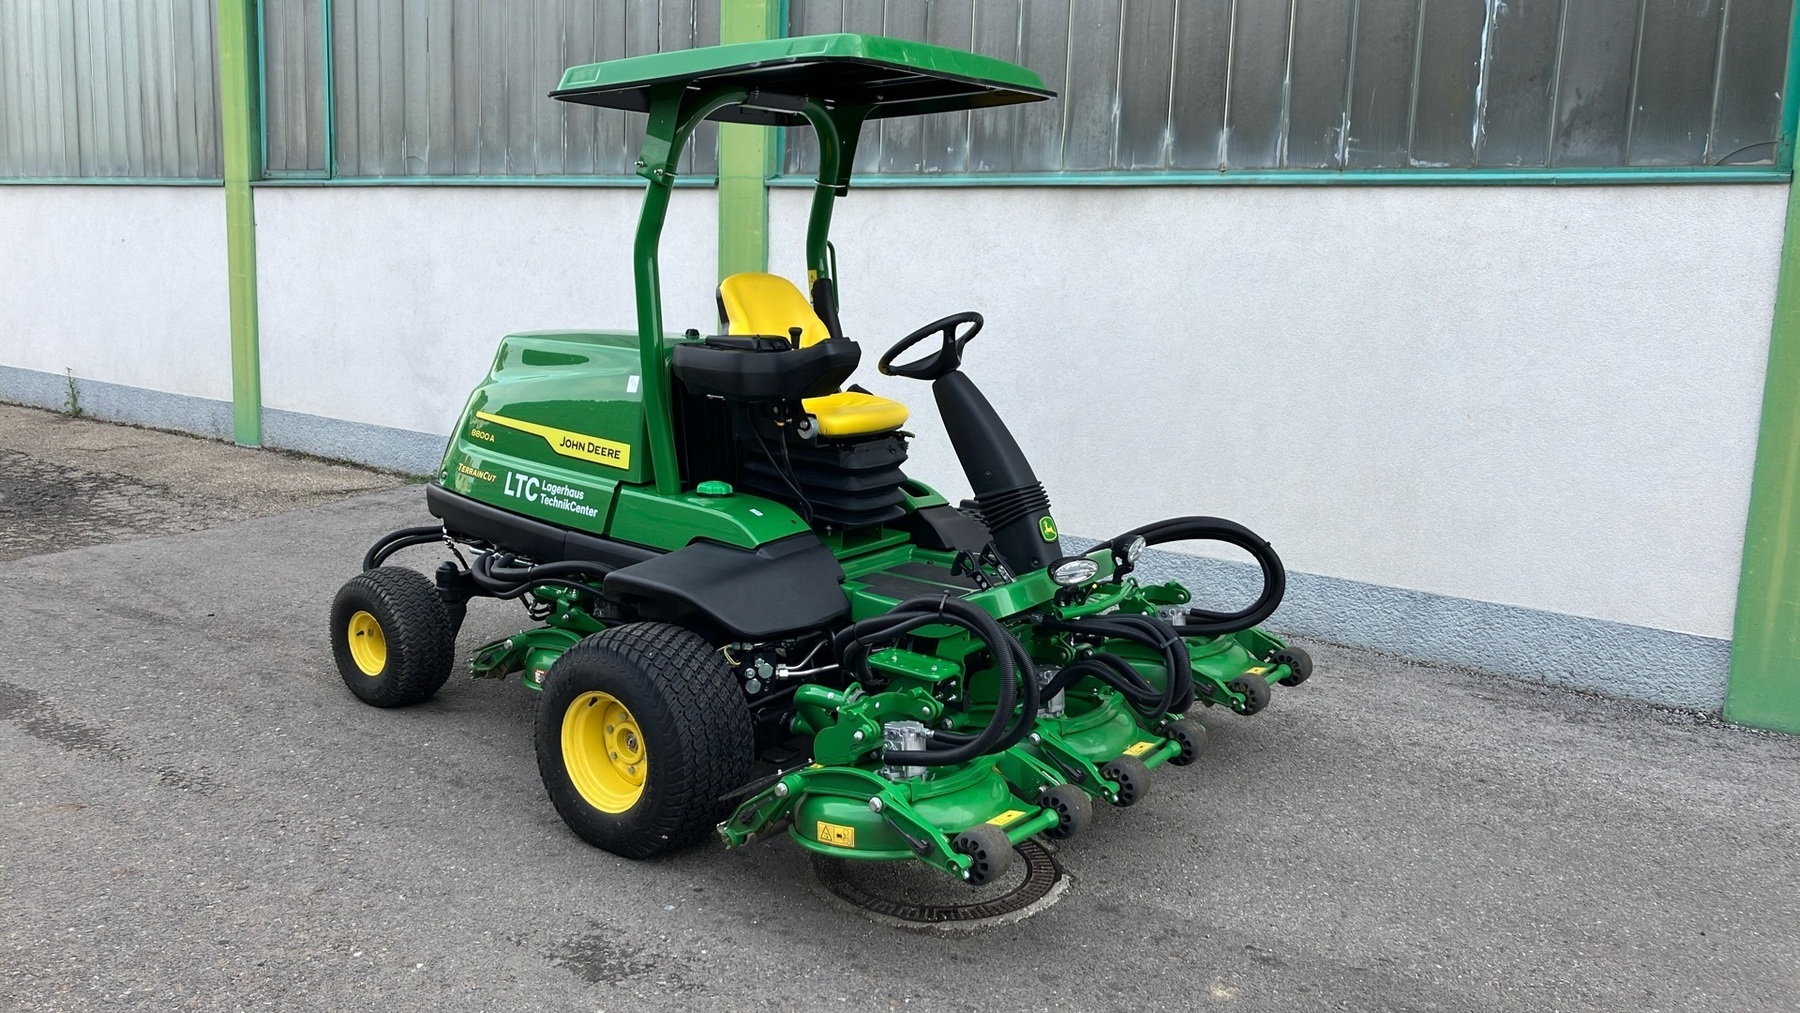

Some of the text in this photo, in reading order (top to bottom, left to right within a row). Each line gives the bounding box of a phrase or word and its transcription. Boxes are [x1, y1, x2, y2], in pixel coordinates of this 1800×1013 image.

[560, 436, 621, 460] JOHN DEERE
[504, 471, 539, 501] LTC
[541, 480, 584, 500] Lagerhaus
[540, 494, 598, 518] TechnikCenter
